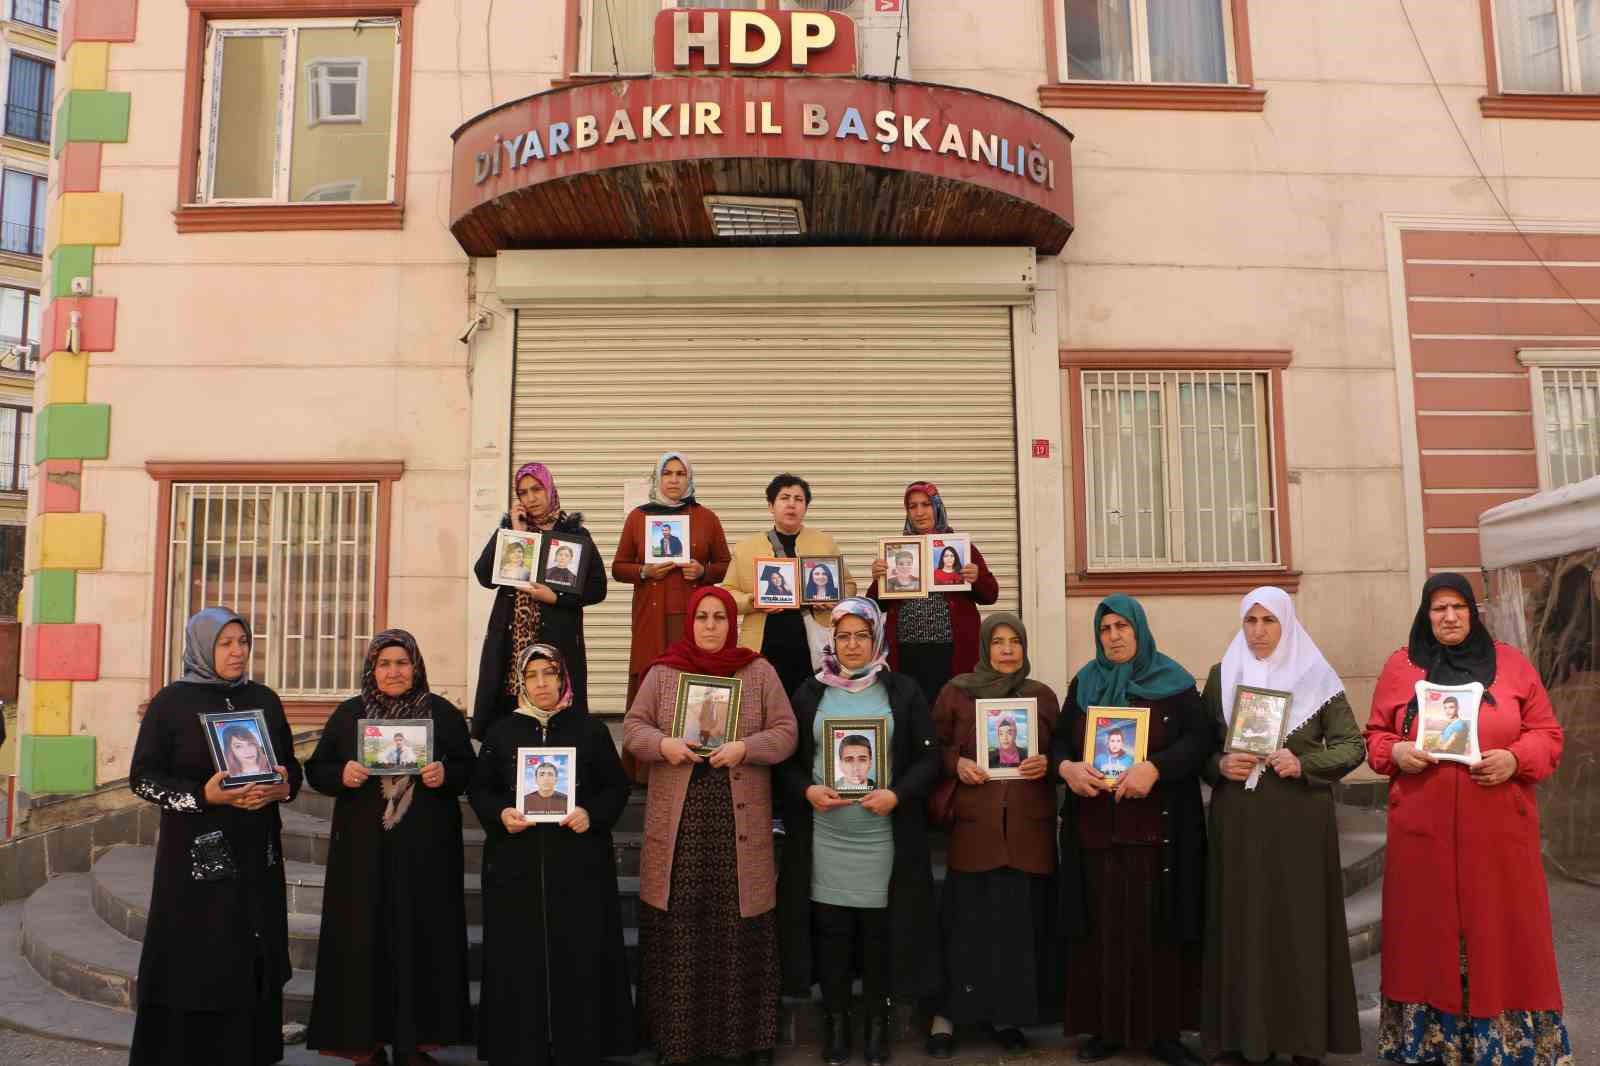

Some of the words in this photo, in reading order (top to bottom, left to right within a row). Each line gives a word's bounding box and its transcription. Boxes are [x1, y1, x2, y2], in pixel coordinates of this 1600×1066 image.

[673, 10, 836, 67] HDP
[475, 101, 724, 185] DİYARBAKIR
[803, 103, 1055, 190] BAŞKANLIĞI
